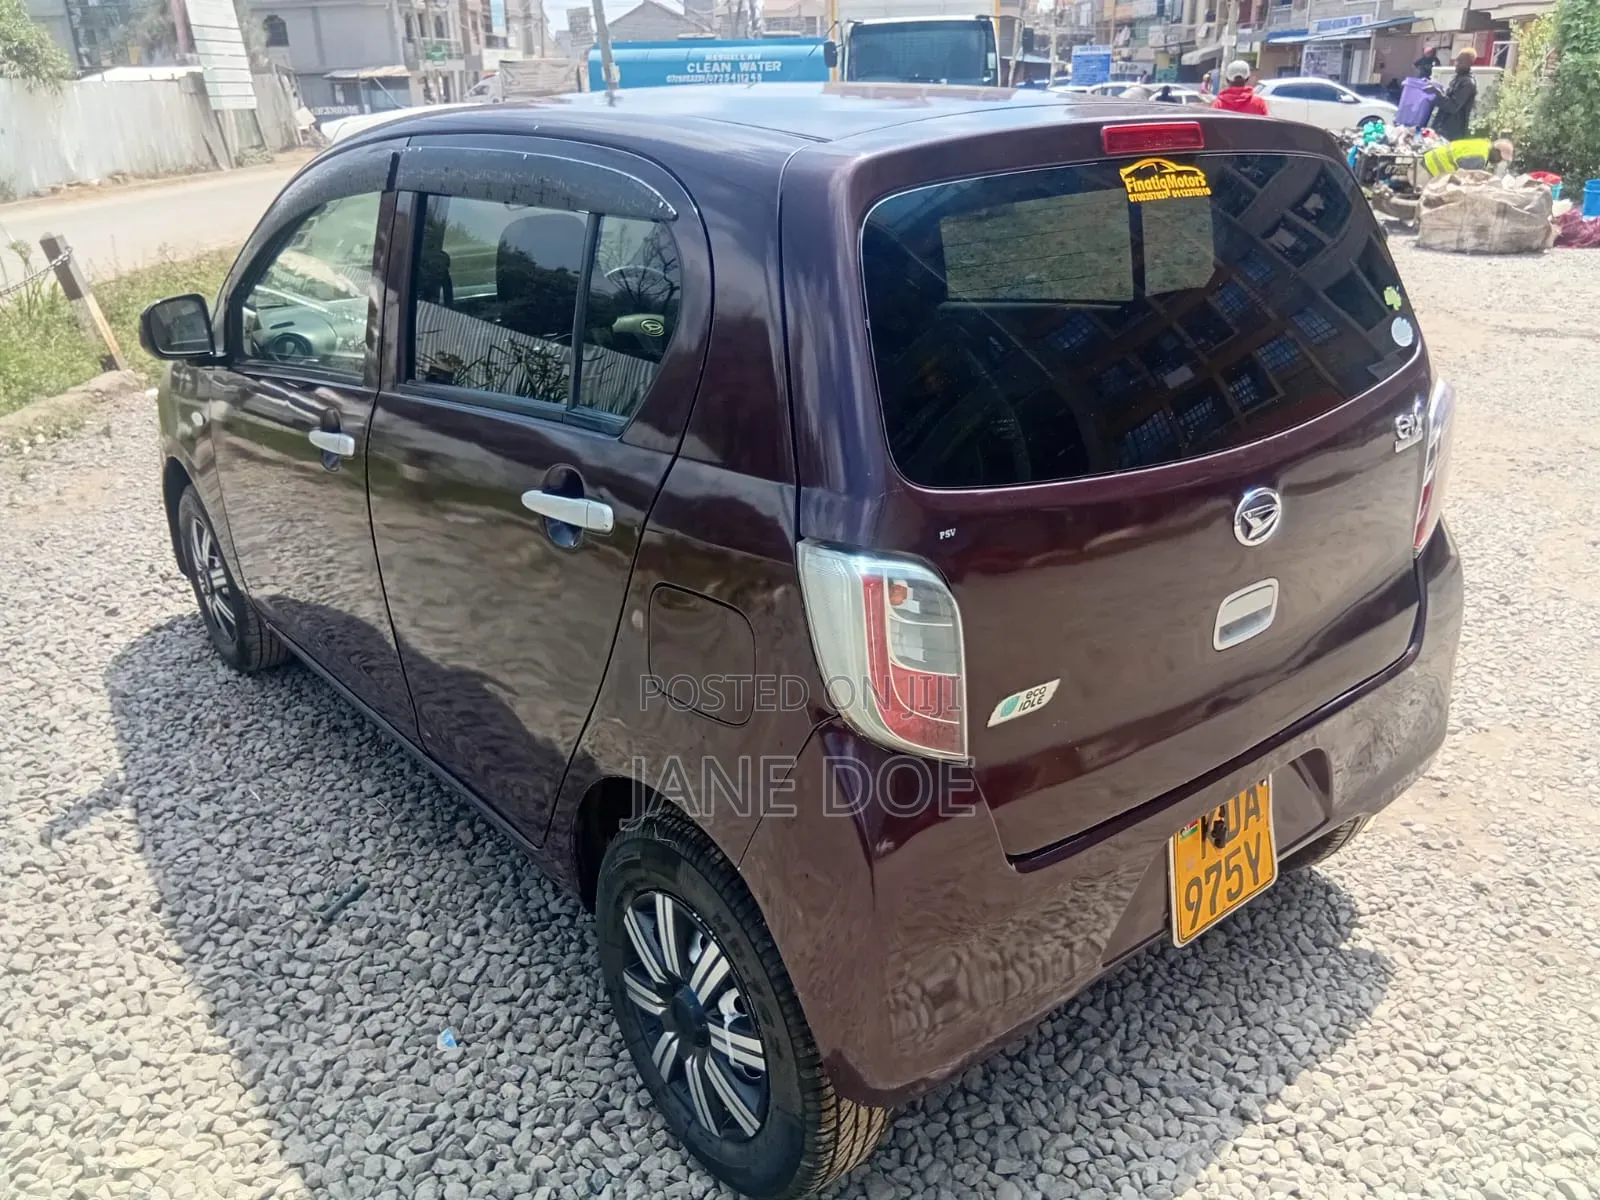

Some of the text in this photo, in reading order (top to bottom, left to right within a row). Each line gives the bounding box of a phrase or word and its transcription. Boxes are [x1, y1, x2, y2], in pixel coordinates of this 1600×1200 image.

[687, 61, 782, 73] CLEAN WATER
[939, 527, 957, 540] PSV
[1025, 686, 1047, 700] eco
[1018, 694, 1045, 712] IDLE
[1184, 831, 1262, 931] 975Y
